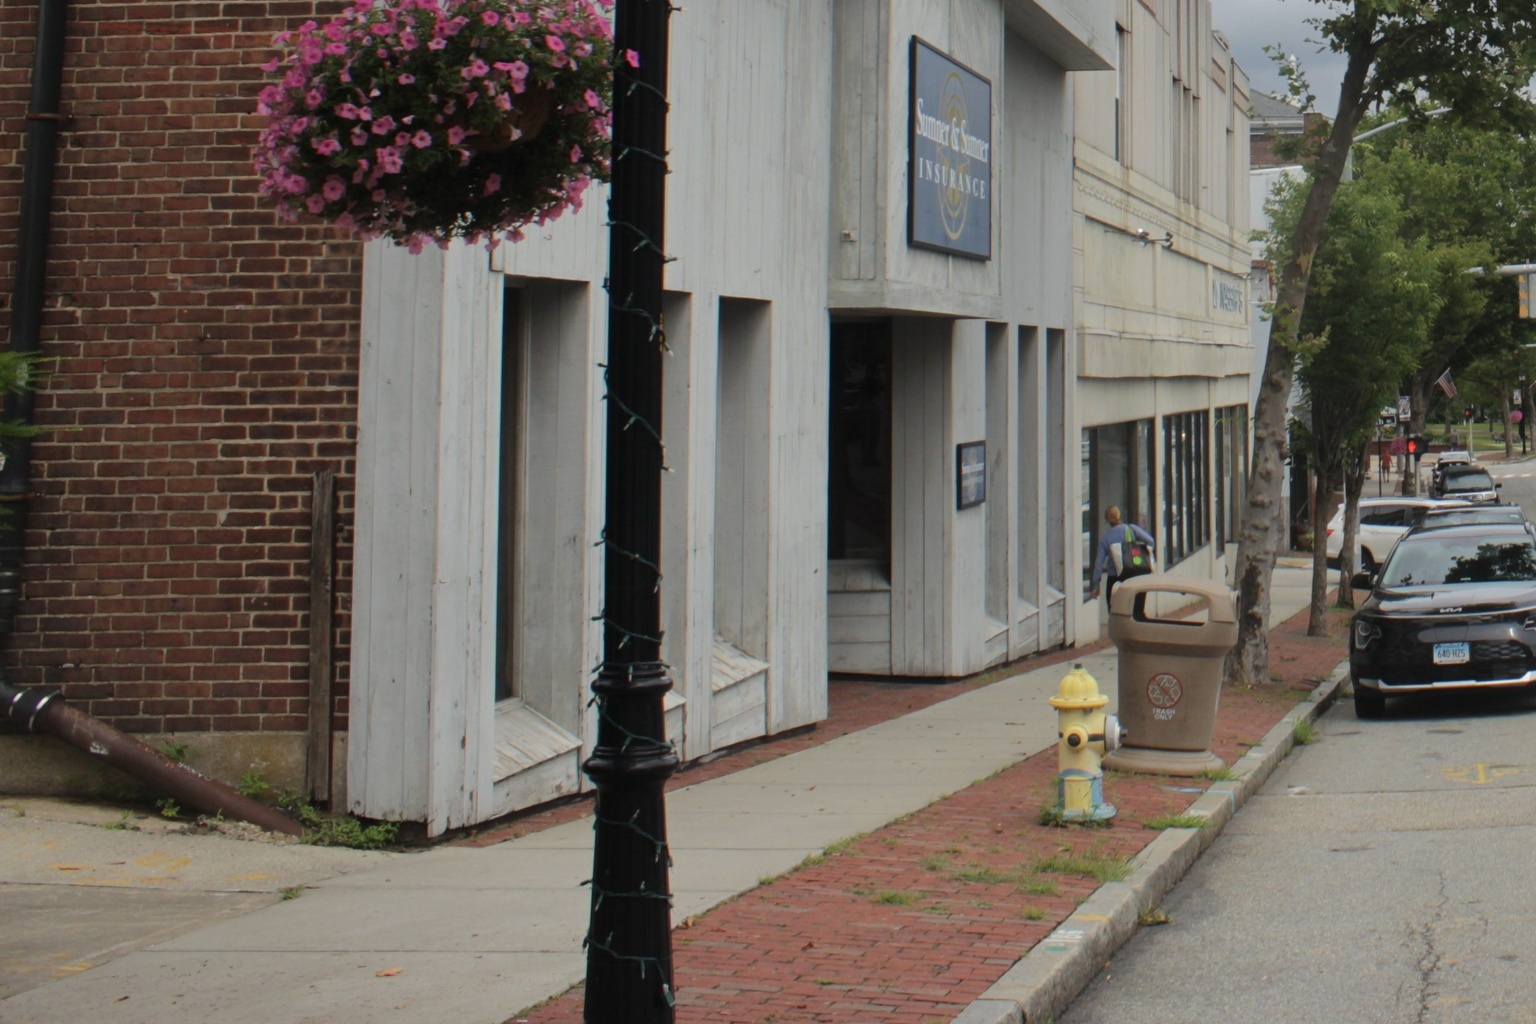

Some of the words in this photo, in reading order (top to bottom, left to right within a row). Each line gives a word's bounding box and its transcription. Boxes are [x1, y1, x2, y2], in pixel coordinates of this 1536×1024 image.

[916, 97, 950, 147] Sumner
[950, 117, 960, 152] &
[961, 119, 990, 164] Sumner
[919, 157, 986, 200] INSURANCE
[1152, 707, 1176, 715] TRASH
